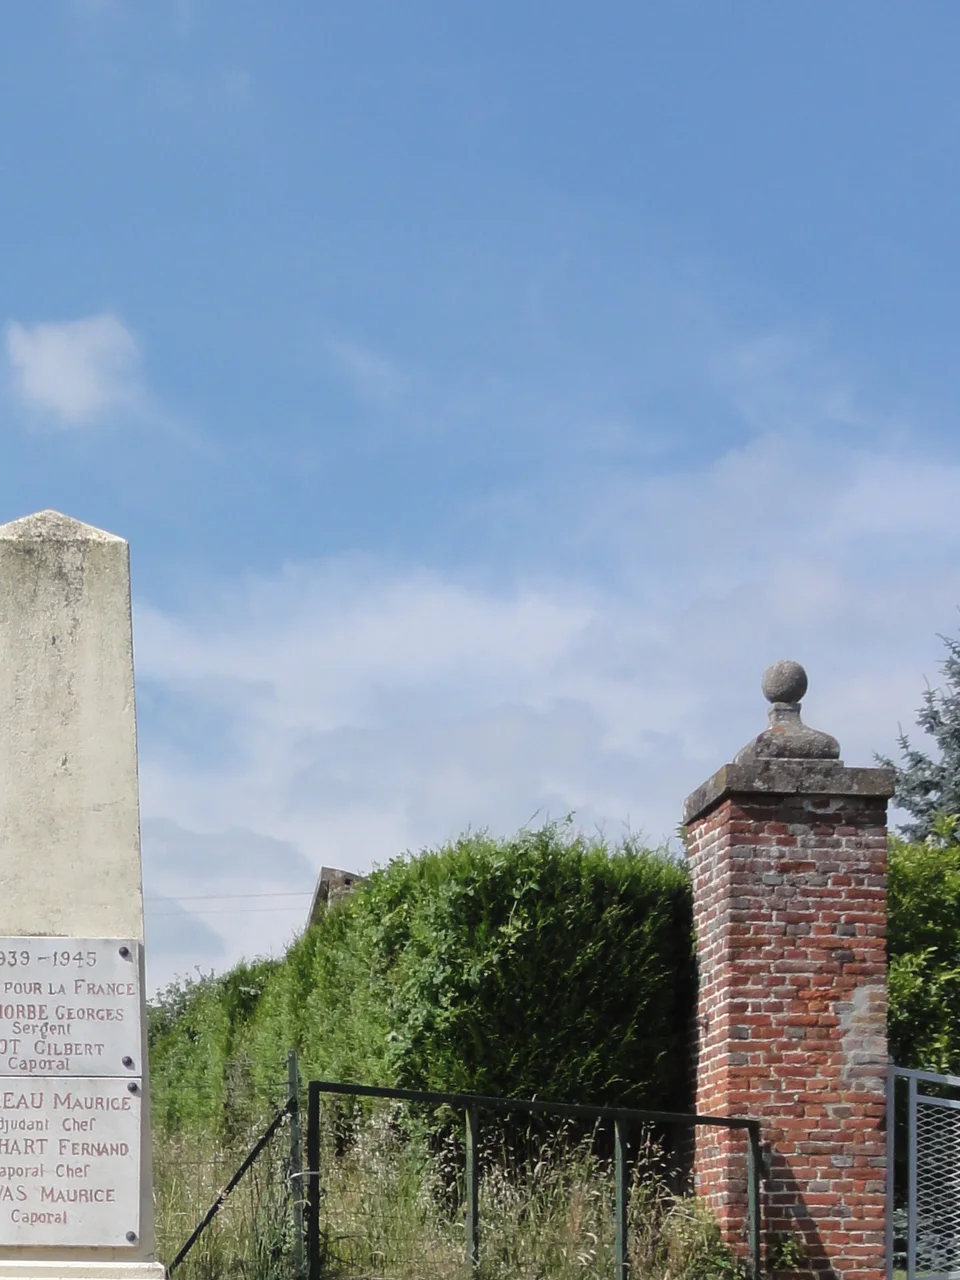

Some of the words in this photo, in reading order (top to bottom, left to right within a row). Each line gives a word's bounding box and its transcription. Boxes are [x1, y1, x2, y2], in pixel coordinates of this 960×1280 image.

[4, 982, 42, 995] POUR
[48, 983, 65, 995] LA
[74, 979, 135, 995] FRANCE
[55, 1005, 124, 1021] GEORGES
[12, 1021, 71, 1039] Sergent
[34, 1040, 104, 1056] GILBERT
[8, 1057, 70, 1072] Caporal
[53, 1093, 131, 1110] MAURICE
[62, 1118, 96, 1131] Chef
[59, 1139, 129, 1156] FERNAND
[55, 1164, 90, 1178] Chef
[41, 1186, 115, 1203] MAURICE
[11, 1209, 67, 1225] Caporal
